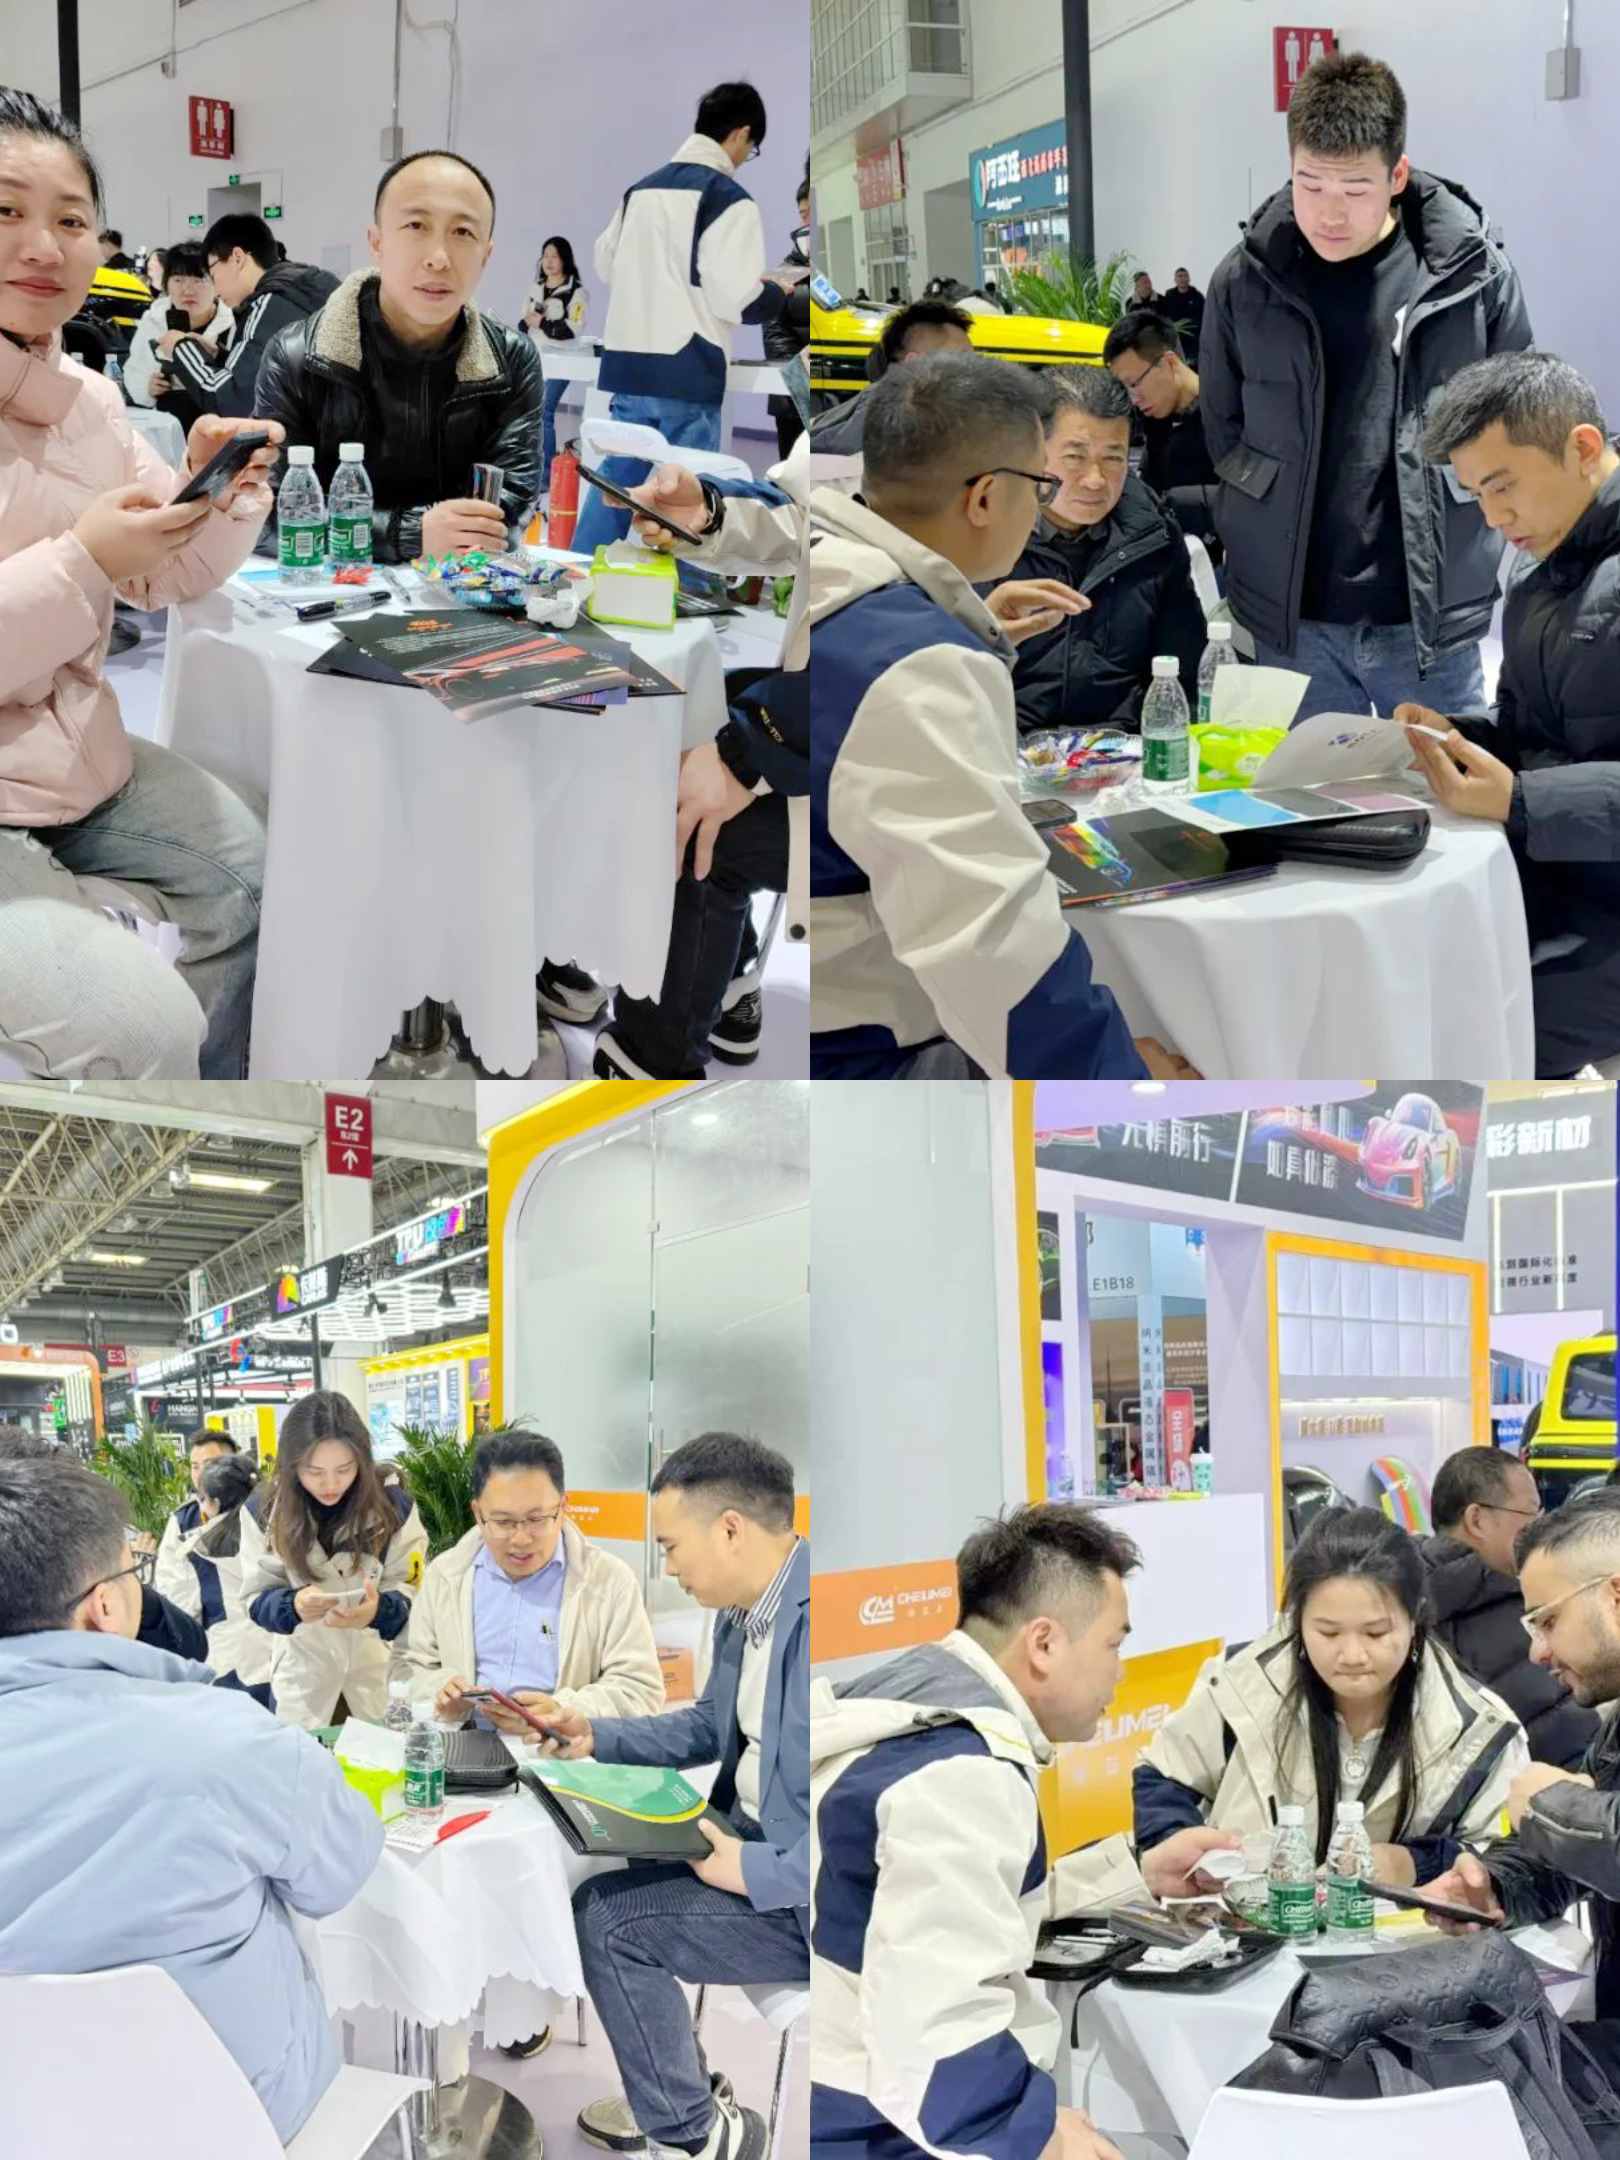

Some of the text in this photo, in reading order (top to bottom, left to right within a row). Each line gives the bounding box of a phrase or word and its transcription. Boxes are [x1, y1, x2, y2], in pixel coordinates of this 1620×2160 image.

[335, 1104, 365, 1132] E2
[1092, 1277, 1135, 1291] E1B18
[107, 1349, 126, 1363] E3
